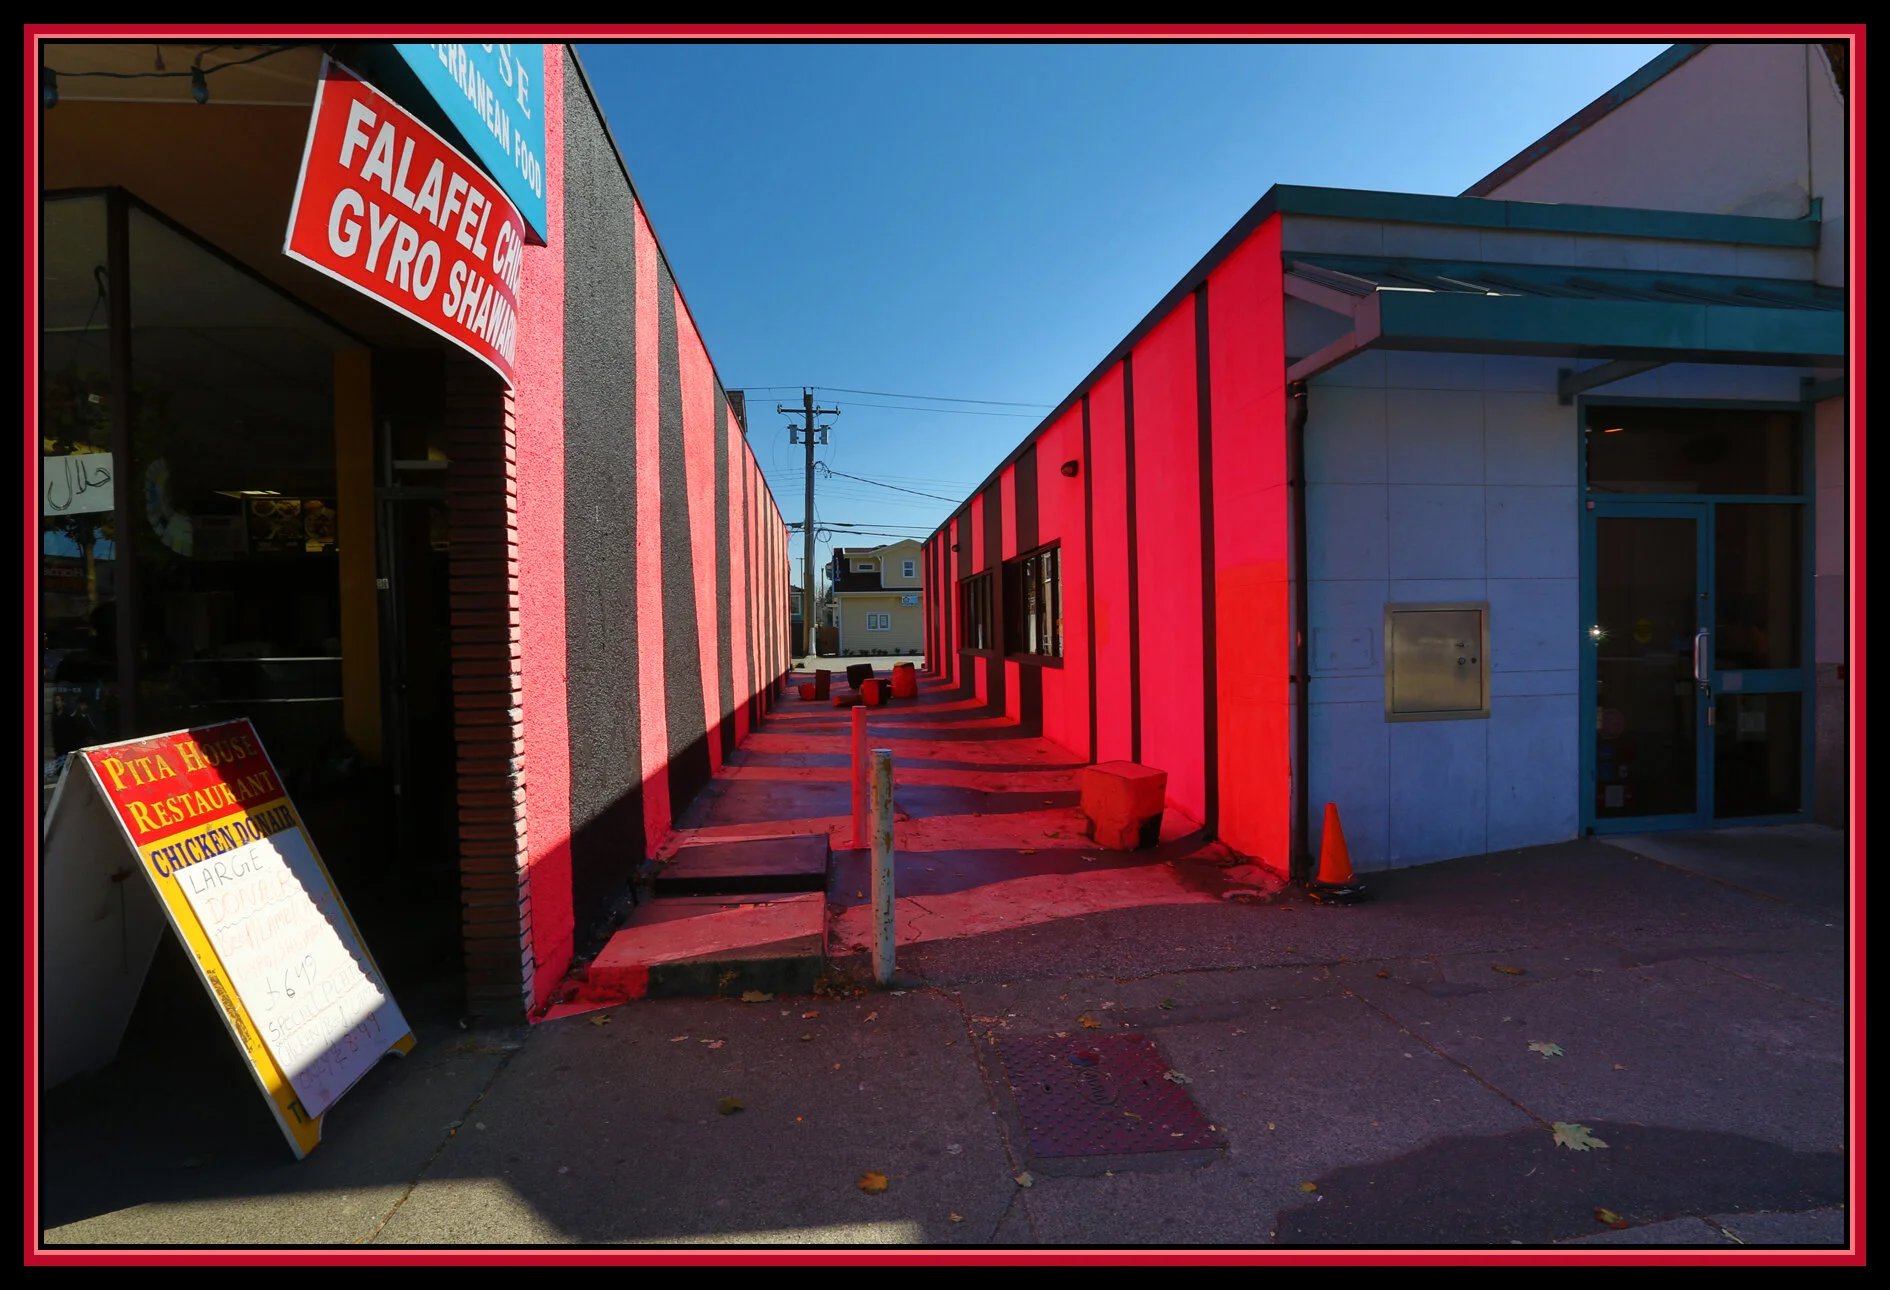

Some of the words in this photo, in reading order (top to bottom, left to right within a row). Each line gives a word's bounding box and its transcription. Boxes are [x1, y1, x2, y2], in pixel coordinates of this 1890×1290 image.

[430, 44, 510, 156] ERRANEAN
[515, 128, 542, 199] FOOD
[339, 98, 492, 261] FALAFEL
[328, 188, 441, 301] GYRO
[47, 457, 111, 511] حلال
[126, 770, 275, 834] RESTAURANT
[151, 824, 233, 878] CHICKEN
[232, 805, 297, 845] DONAIR
[189, 847, 263, 894] LARGE
